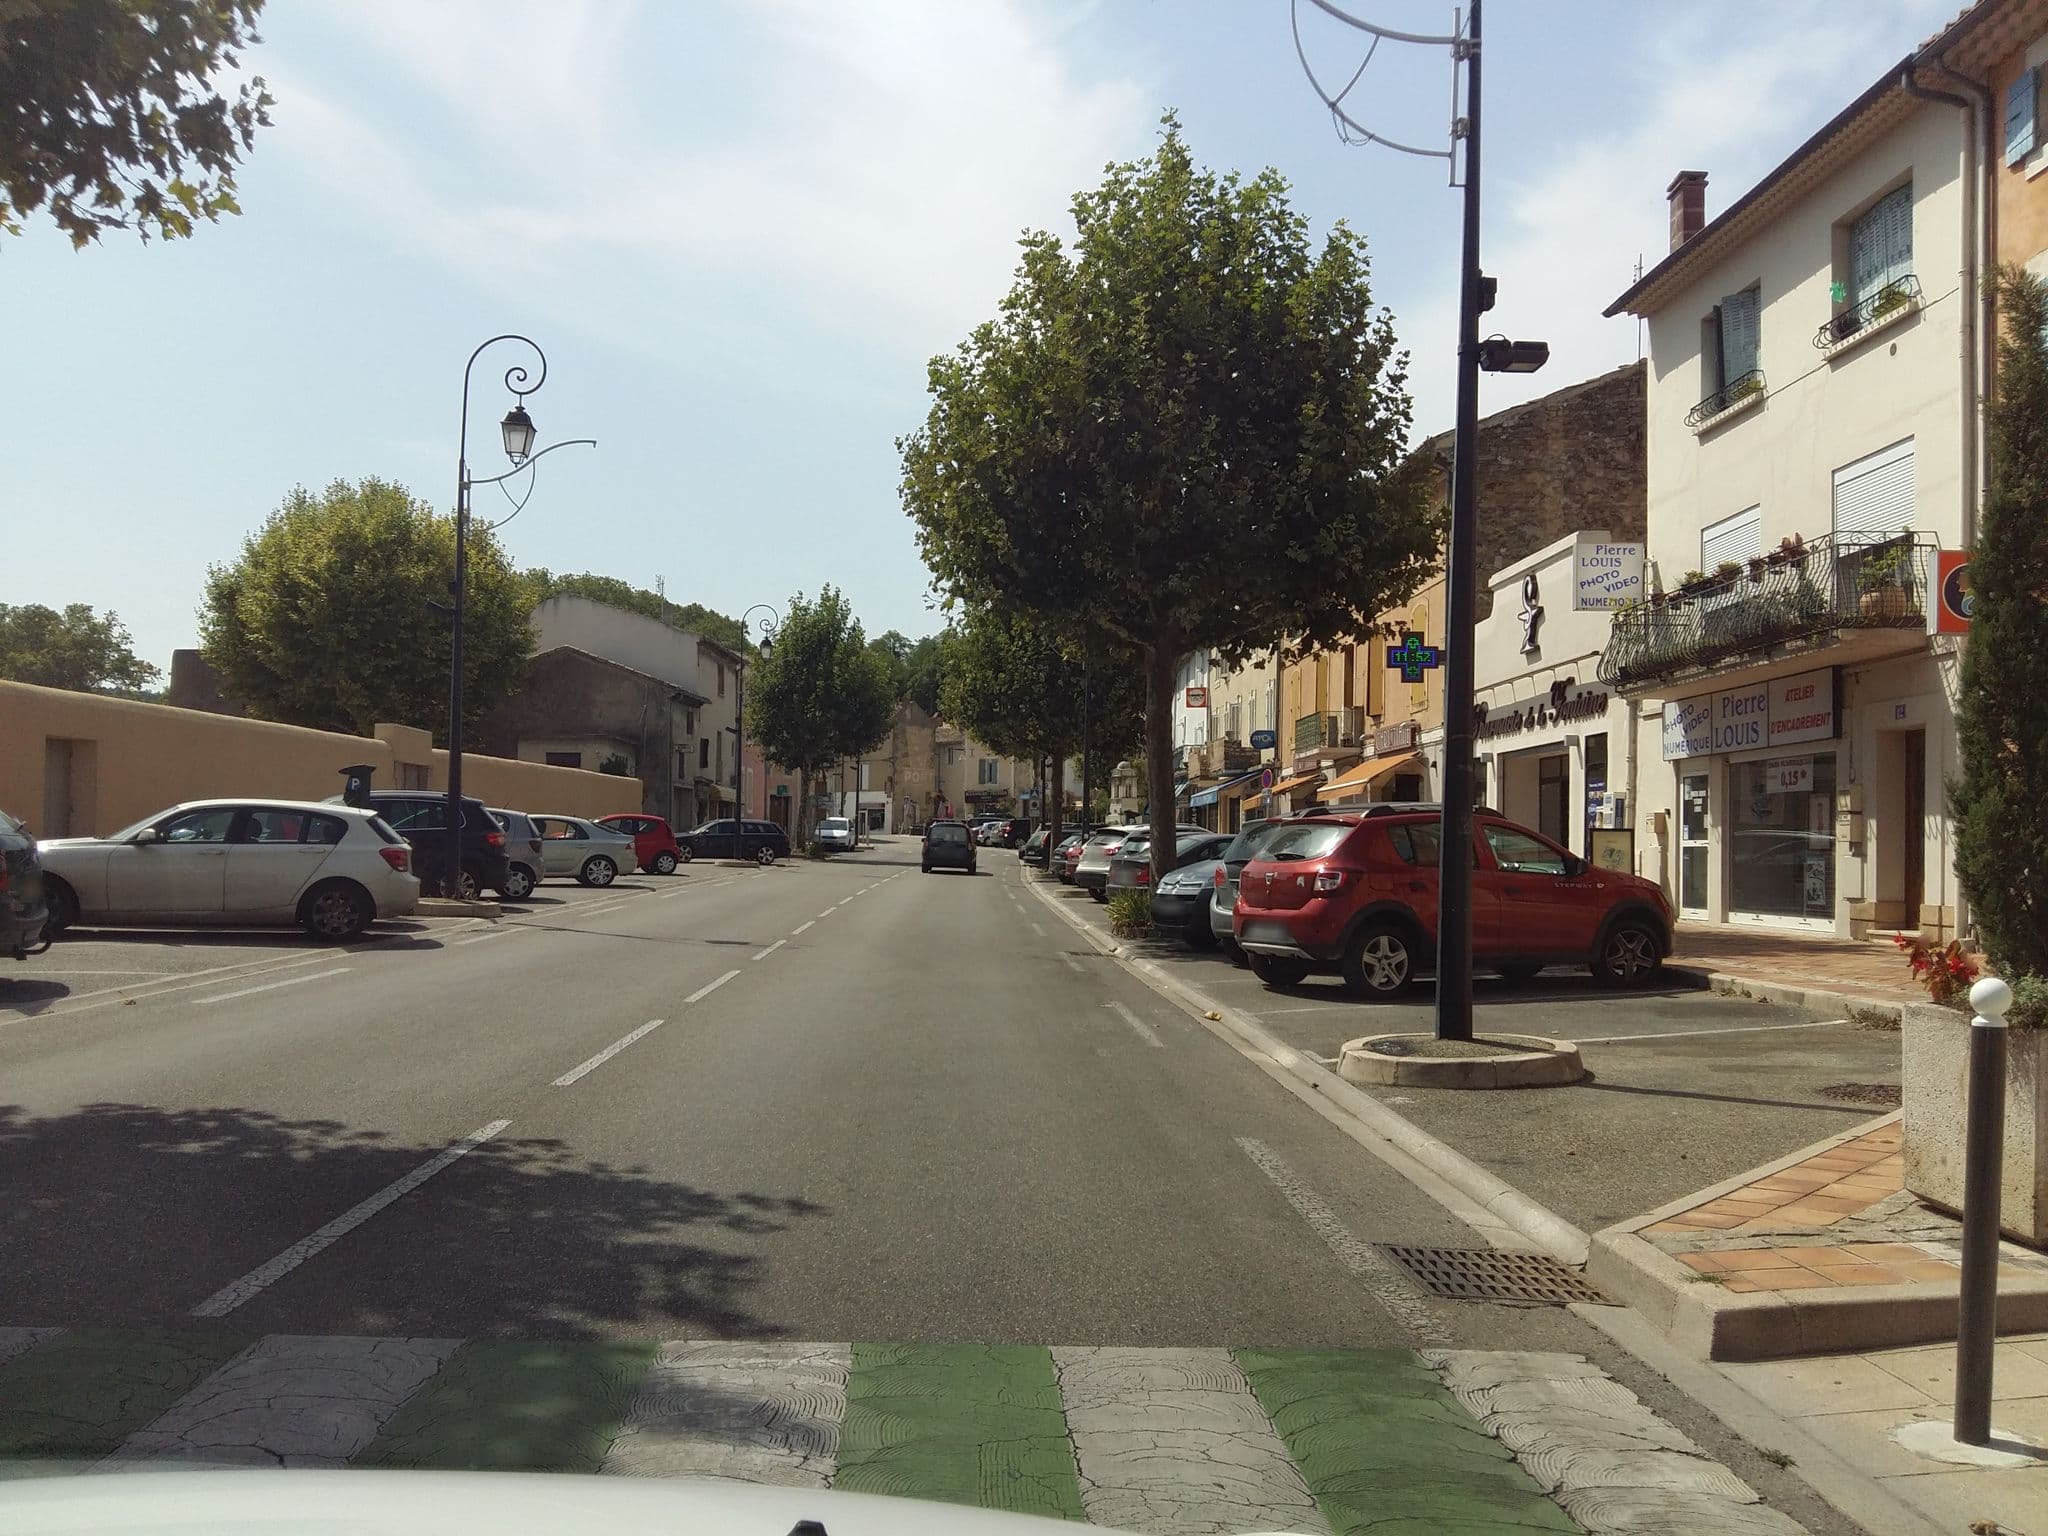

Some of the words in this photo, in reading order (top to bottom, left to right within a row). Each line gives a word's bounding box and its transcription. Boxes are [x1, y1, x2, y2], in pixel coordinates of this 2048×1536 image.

[1595, 544, 1636, 556] Pierre
[1581, 557, 1622, 567] LOUIS
[1579, 569, 1620, 590] PHOTO
[1603, 575, 1639, 593] VIDEO
[1784, 684, 1815, 703] ATELIER
[1721, 693, 1766, 719] Pierre
[1664, 703, 1695, 735] PHOTO
[1682, 708, 1710, 736] VIDEO
[1770, 711, 1832, 735] D'ENCADREMENT
[1714, 720, 1760, 748] LOUIS
[1664, 736, 1711, 754] NUMERIQUE
[351, 777, 360, 790] P
